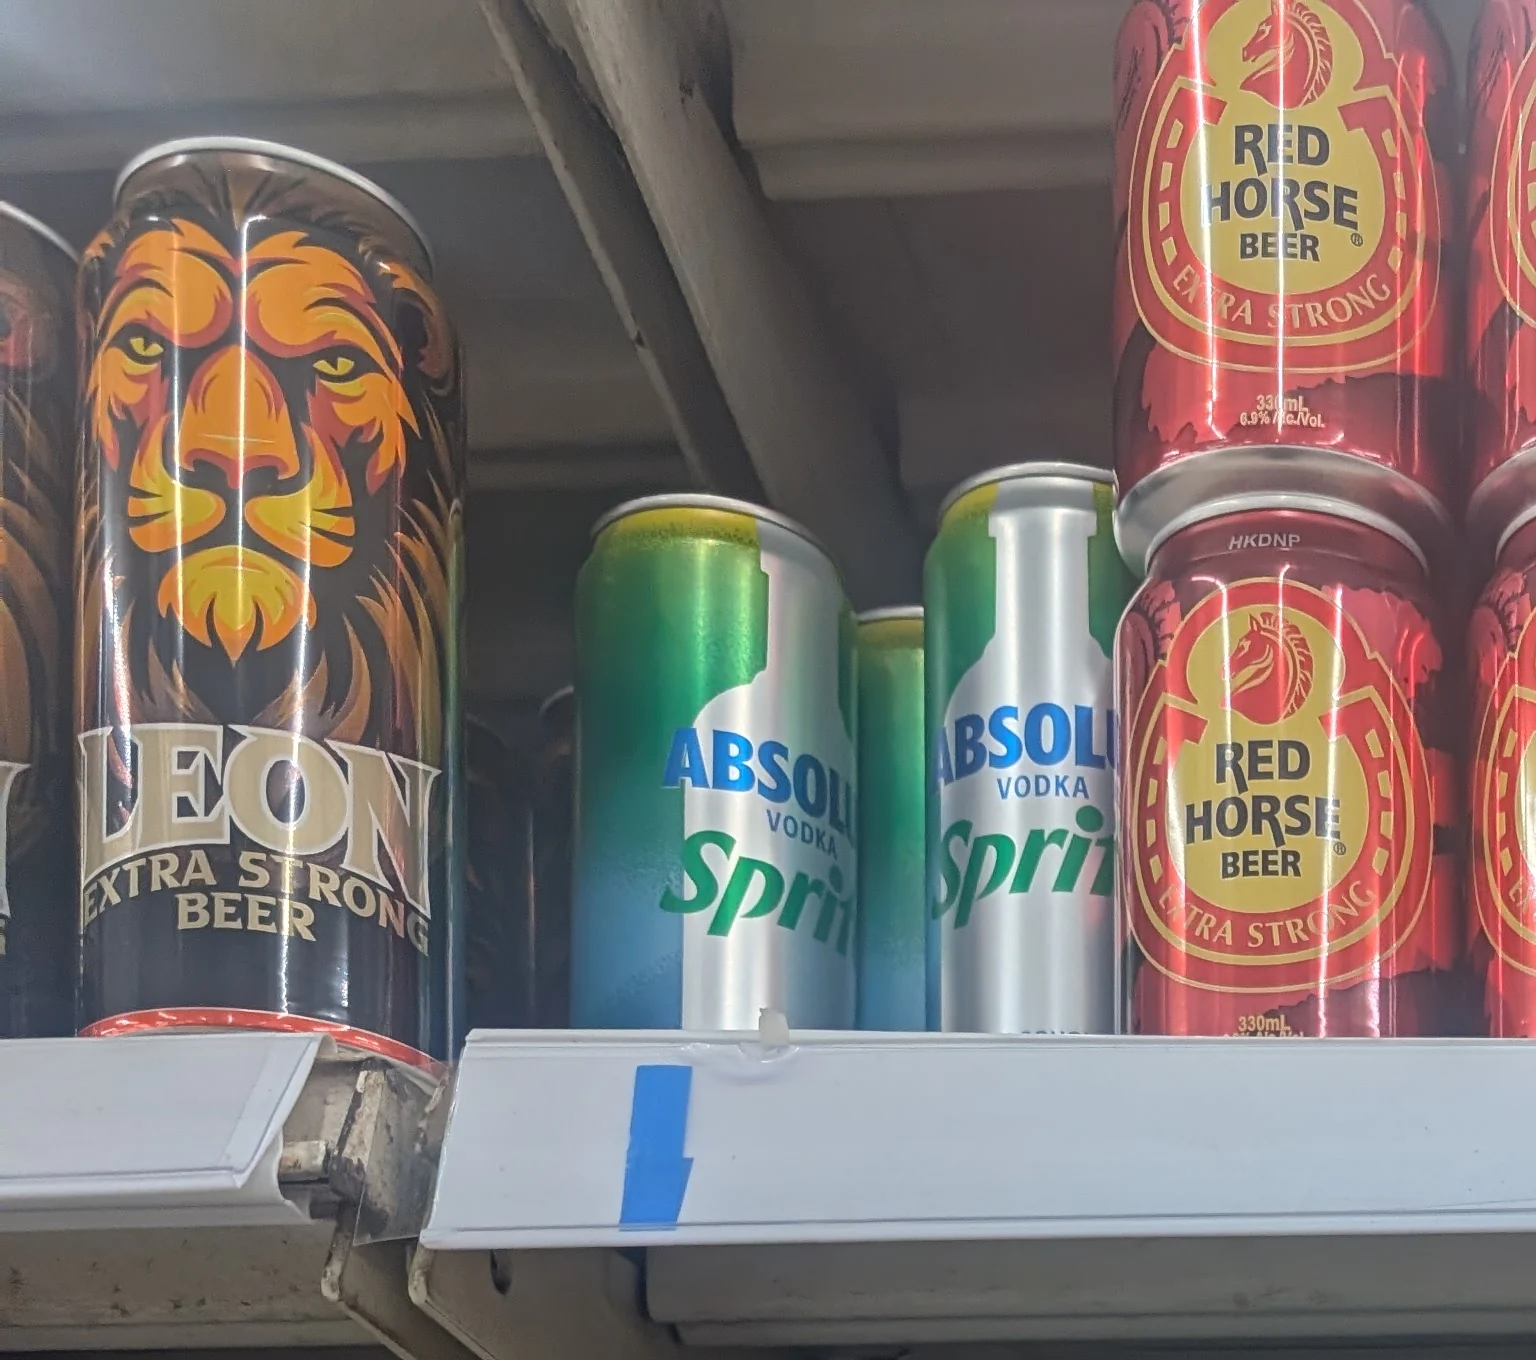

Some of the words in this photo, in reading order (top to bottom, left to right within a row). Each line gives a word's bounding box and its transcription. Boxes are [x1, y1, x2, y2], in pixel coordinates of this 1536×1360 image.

[1229, 533, 1301, 551] HKDNP
[997, 775, 1089, 800] VODKA
[1214, 739, 1311, 793] RED
[77, 723, 442, 920] LEON
[766, 809, 837, 860] VODKA
[1185, 795, 1341, 846] HORSE
[1220, 848, 1301, 879] BEER
[83, 850, 218, 931] EXTRA
[239, 851, 430, 957] STRONG
[176, 893, 317, 942] BEER
